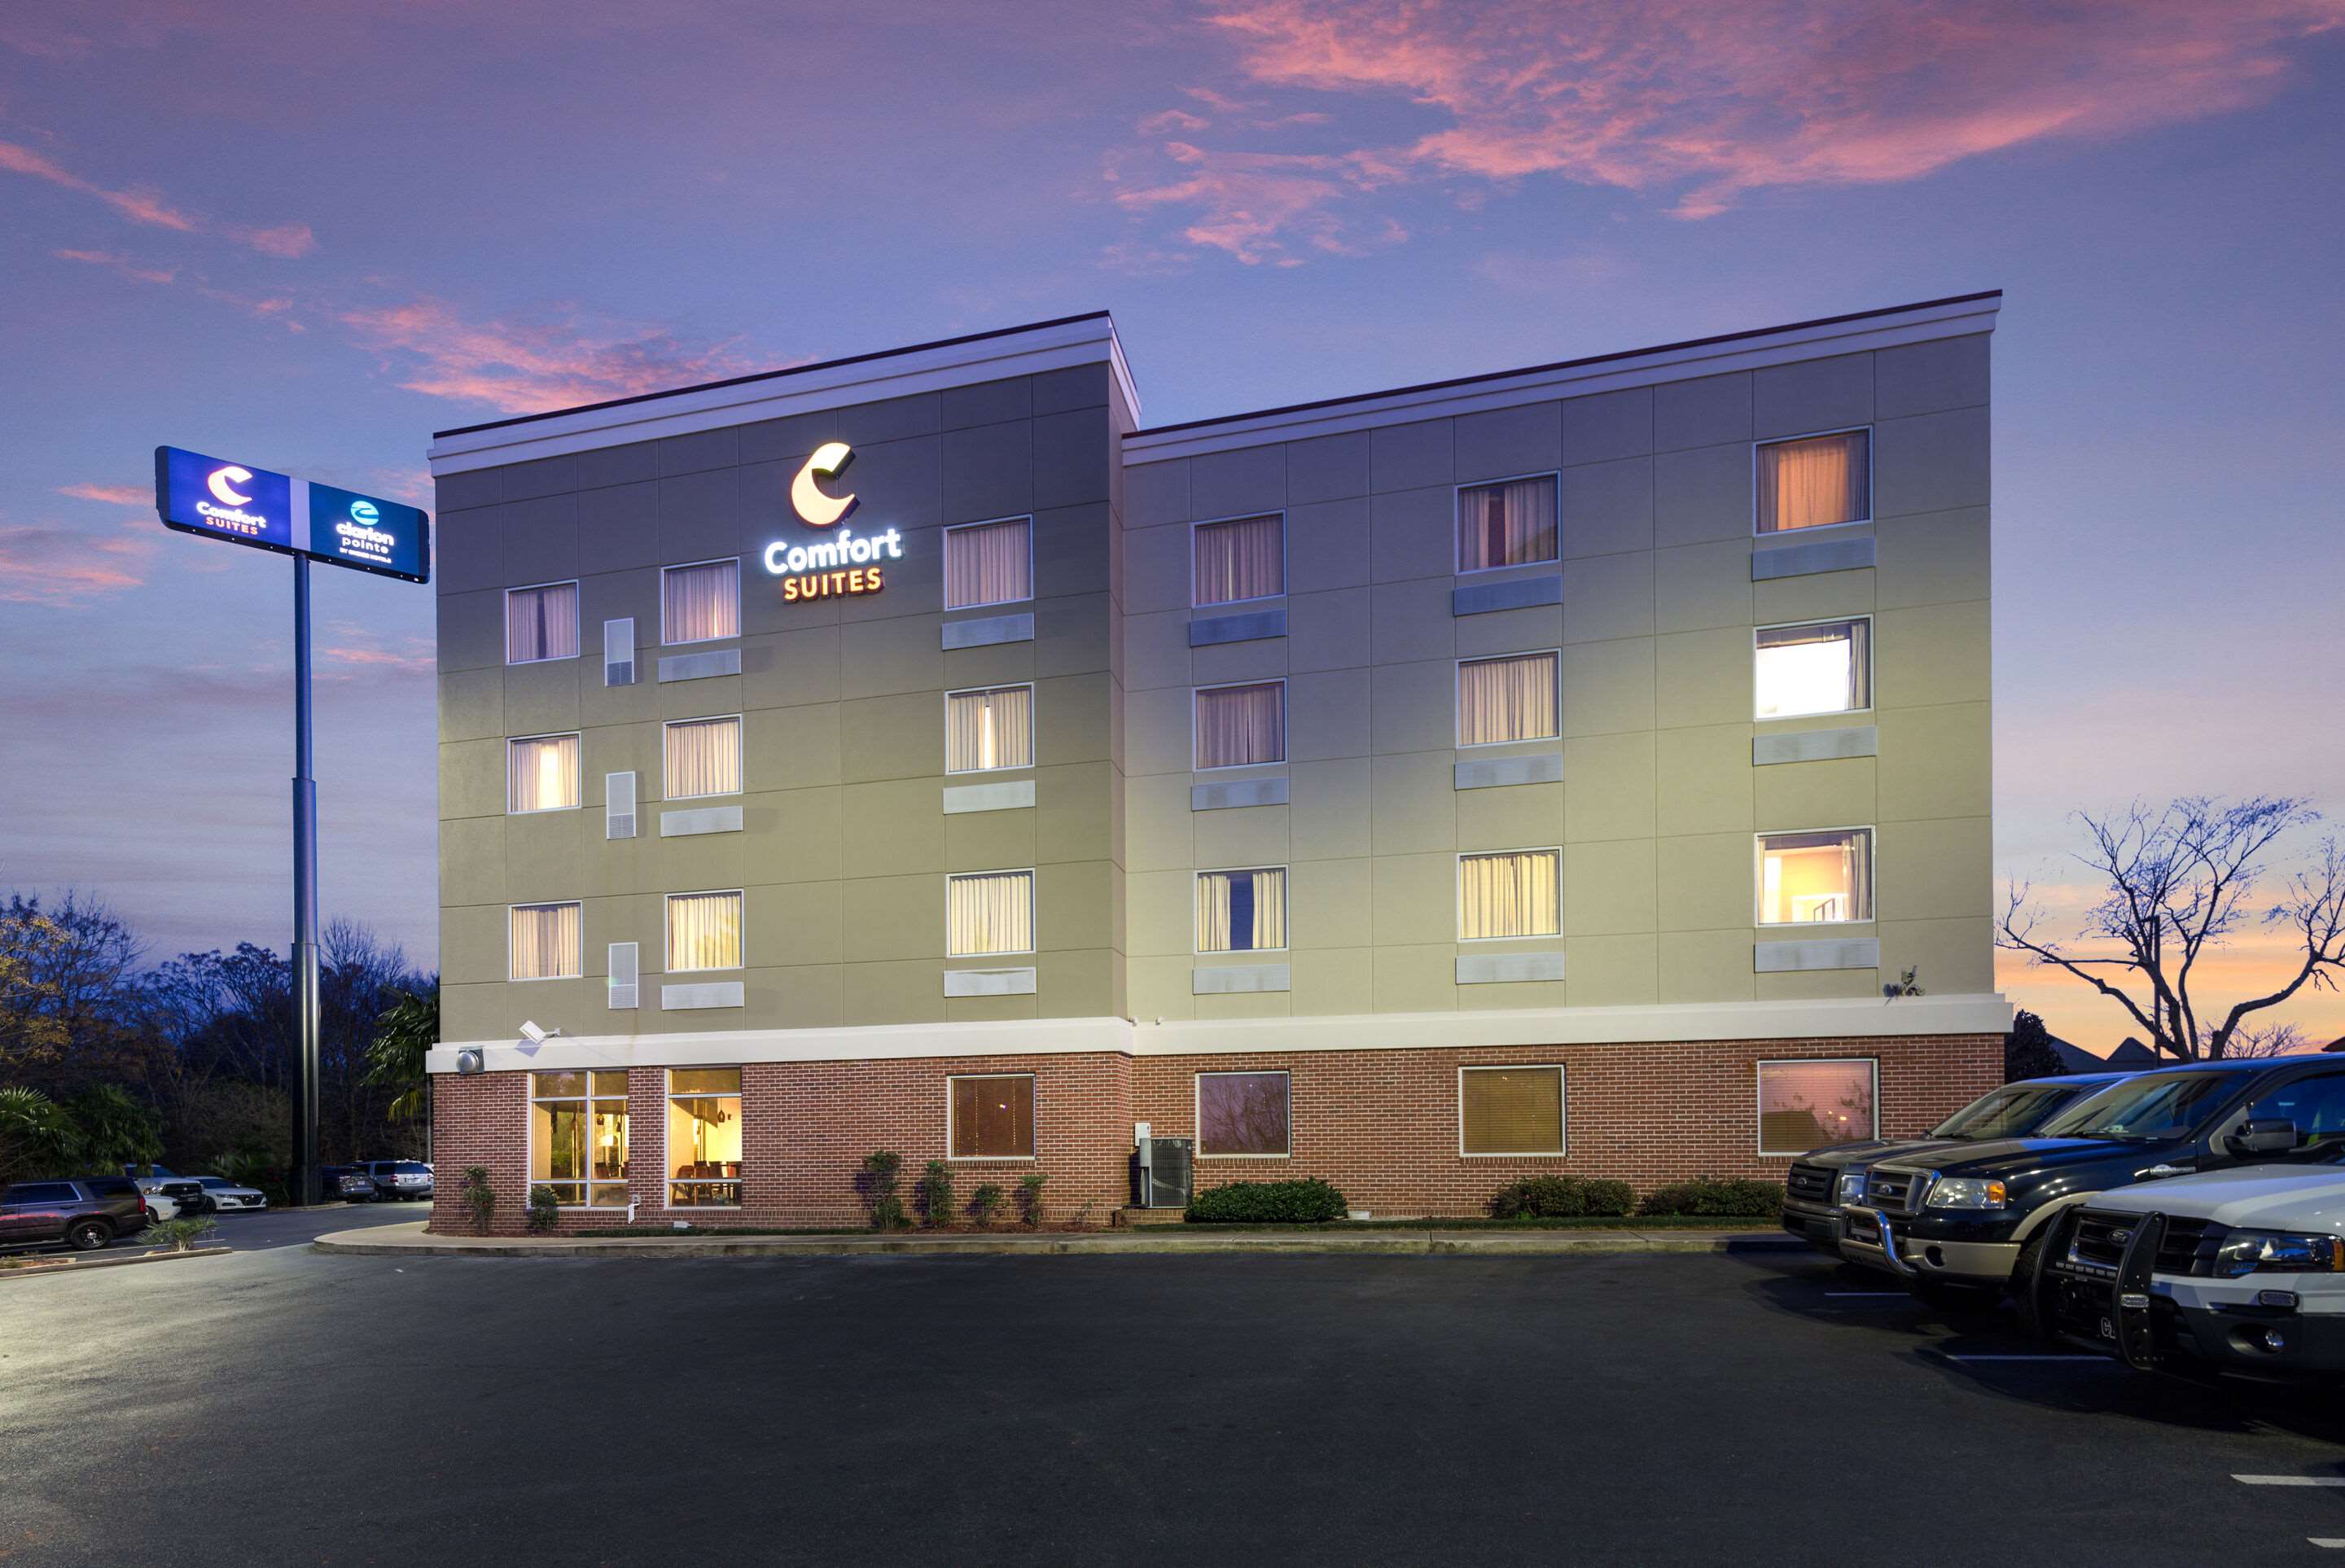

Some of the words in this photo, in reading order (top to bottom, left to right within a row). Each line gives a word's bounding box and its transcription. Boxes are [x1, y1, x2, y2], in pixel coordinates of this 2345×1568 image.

[196, 501, 267, 528] Comfort
[206, 516, 258, 535] SUITES
[342, 537, 388, 554] pointe
[765, 528, 902, 574] Comfort
[784, 567, 883, 600] SUITES
